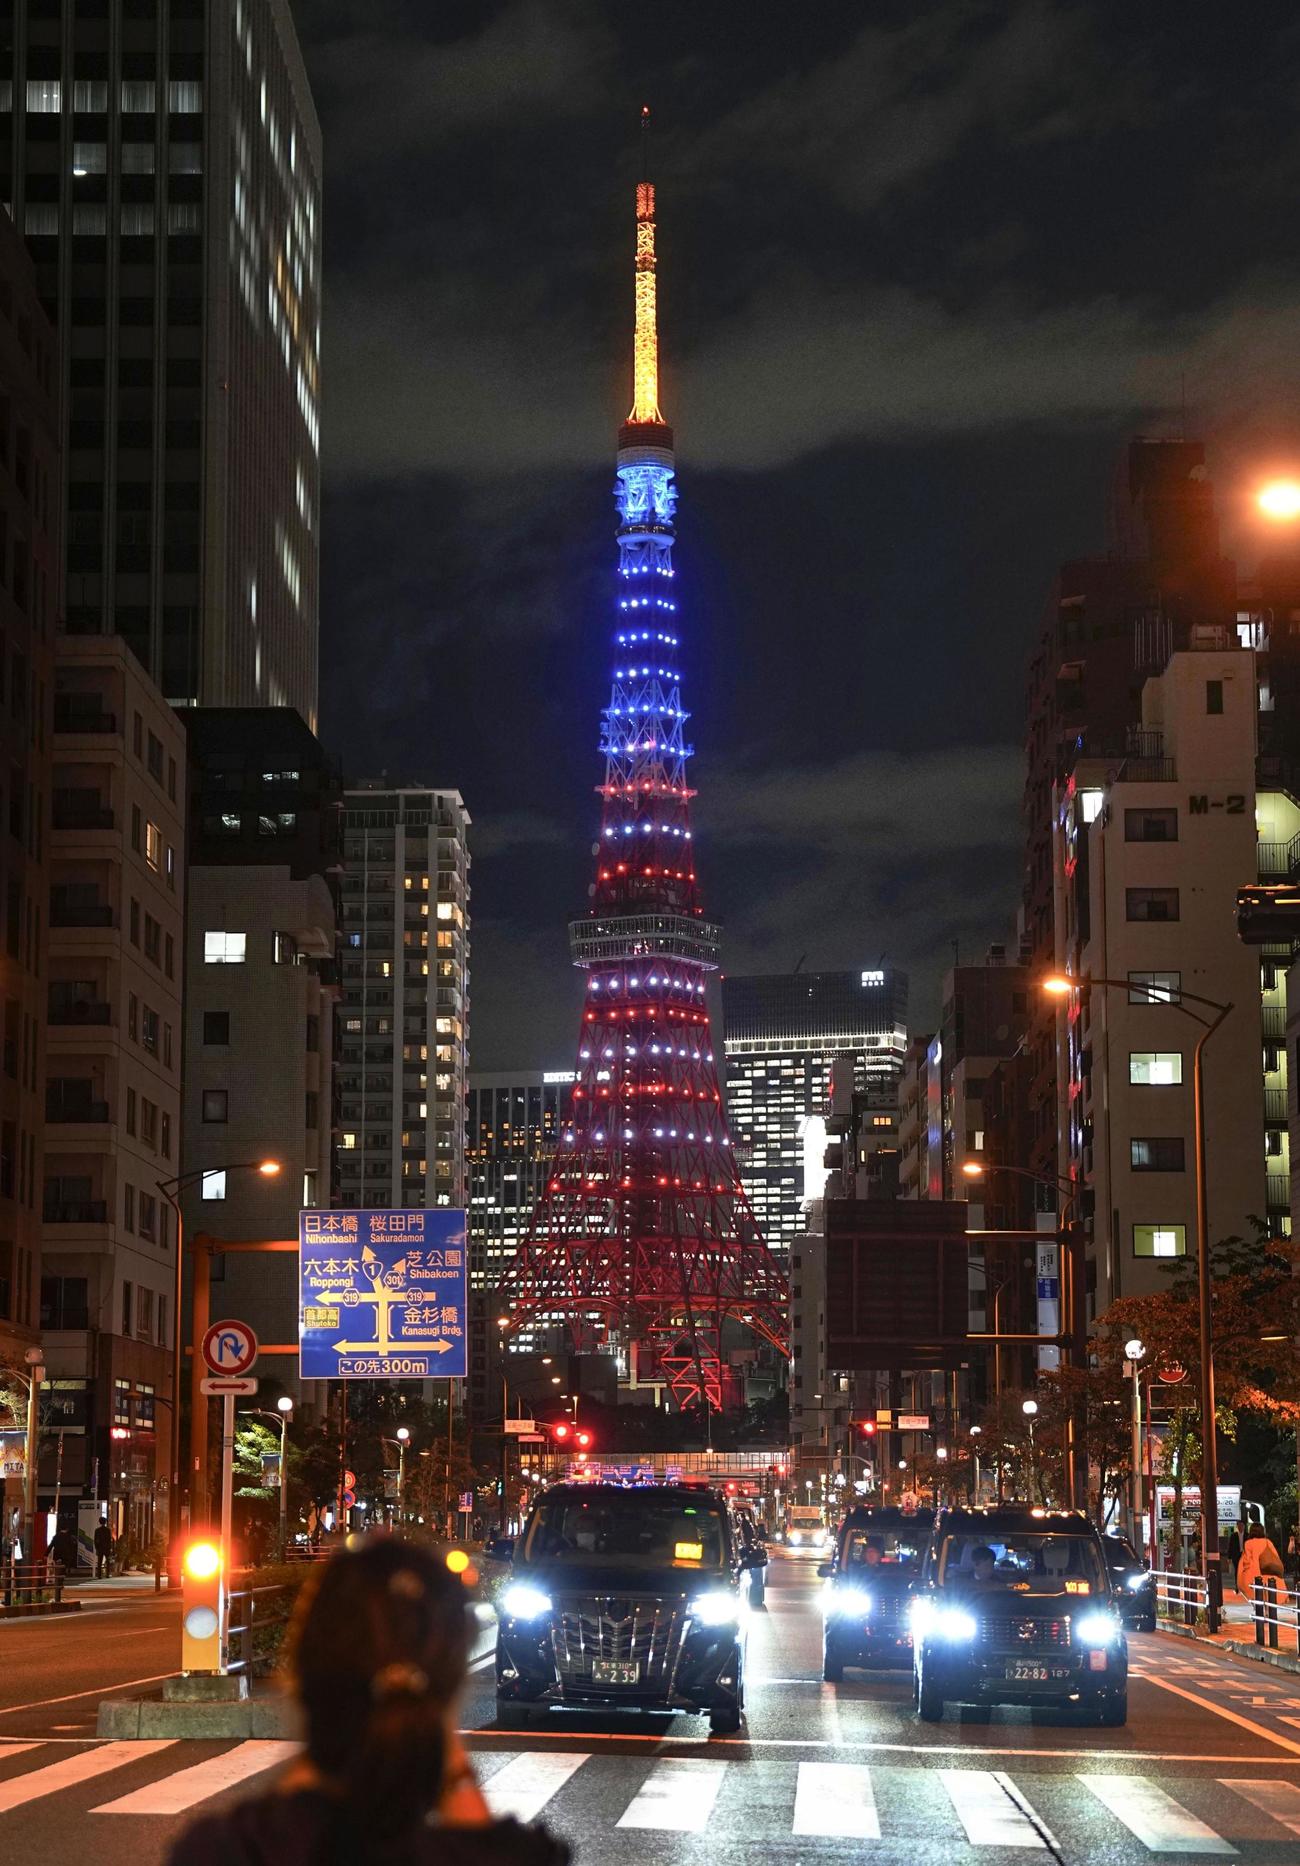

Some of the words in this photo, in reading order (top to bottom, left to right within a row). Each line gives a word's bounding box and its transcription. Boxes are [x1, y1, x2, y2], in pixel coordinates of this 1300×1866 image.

[1189, 795, 1246, 815] M-2
[305, 1215, 359, 1233] 日本橋
[369, 1214, 425, 1232] 桜田門
[305, 1233, 358, 1244] Nihonbashi
[370, 1232, 425, 1243] Sakuradamon
[406, 1250, 462, 1268] 芝公園
[304, 1257, 360, 1276] 六本木
[369, 1264, 376, 1276] 1
[409, 1269, 460, 1279] Shibakoen
[309, 1276, 354, 1288] Roppongi
[386, 1275, 401, 1285] 301
[344, 1292, 358, 1303] 319
[408, 1292, 423, 1302] 319
[305, 1309, 338, 1320] 首都高
[404, 1306, 458, 1324] 金杉橋
[401, 1326, 440, 1337] Kanasugi
[441, 1326, 464, 1337] Brdg.
[341, 1359, 426, 1373] この先300m
[4, 1462, 25, 1470] MITA
[1014, 1667, 1048, 1680] 22-82
[1051, 1669, 1071, 1678] 127
